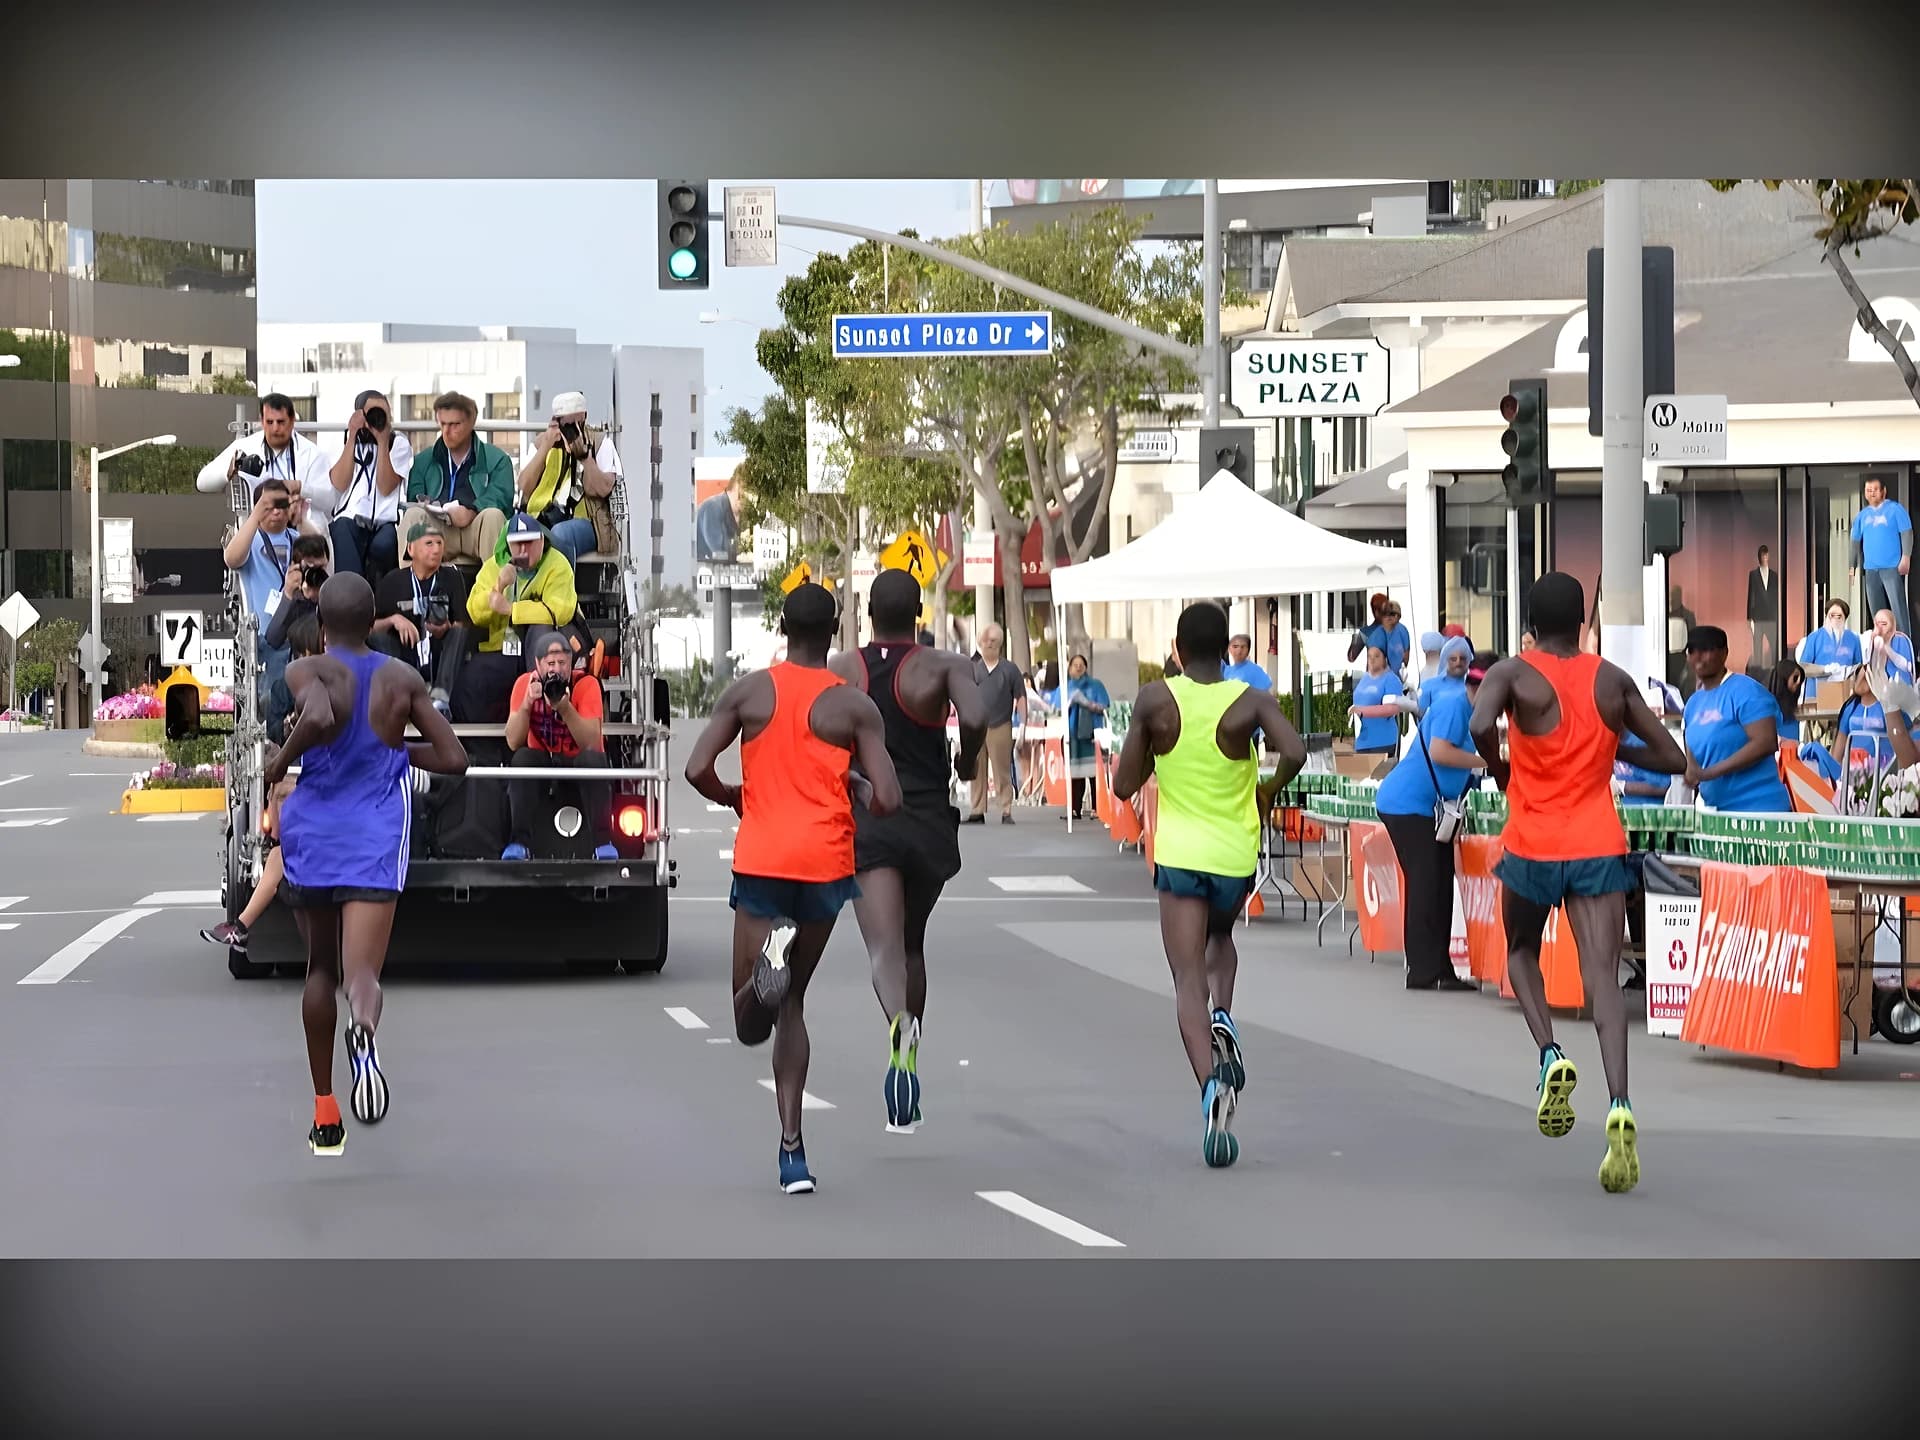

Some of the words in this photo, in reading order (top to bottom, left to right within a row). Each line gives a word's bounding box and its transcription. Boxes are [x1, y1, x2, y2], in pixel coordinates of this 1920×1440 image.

[989, 322, 1012, 345] Dr
[1248, 352, 1369, 374] SUNSET
[1259, 381, 1361, 403] PLAZA
